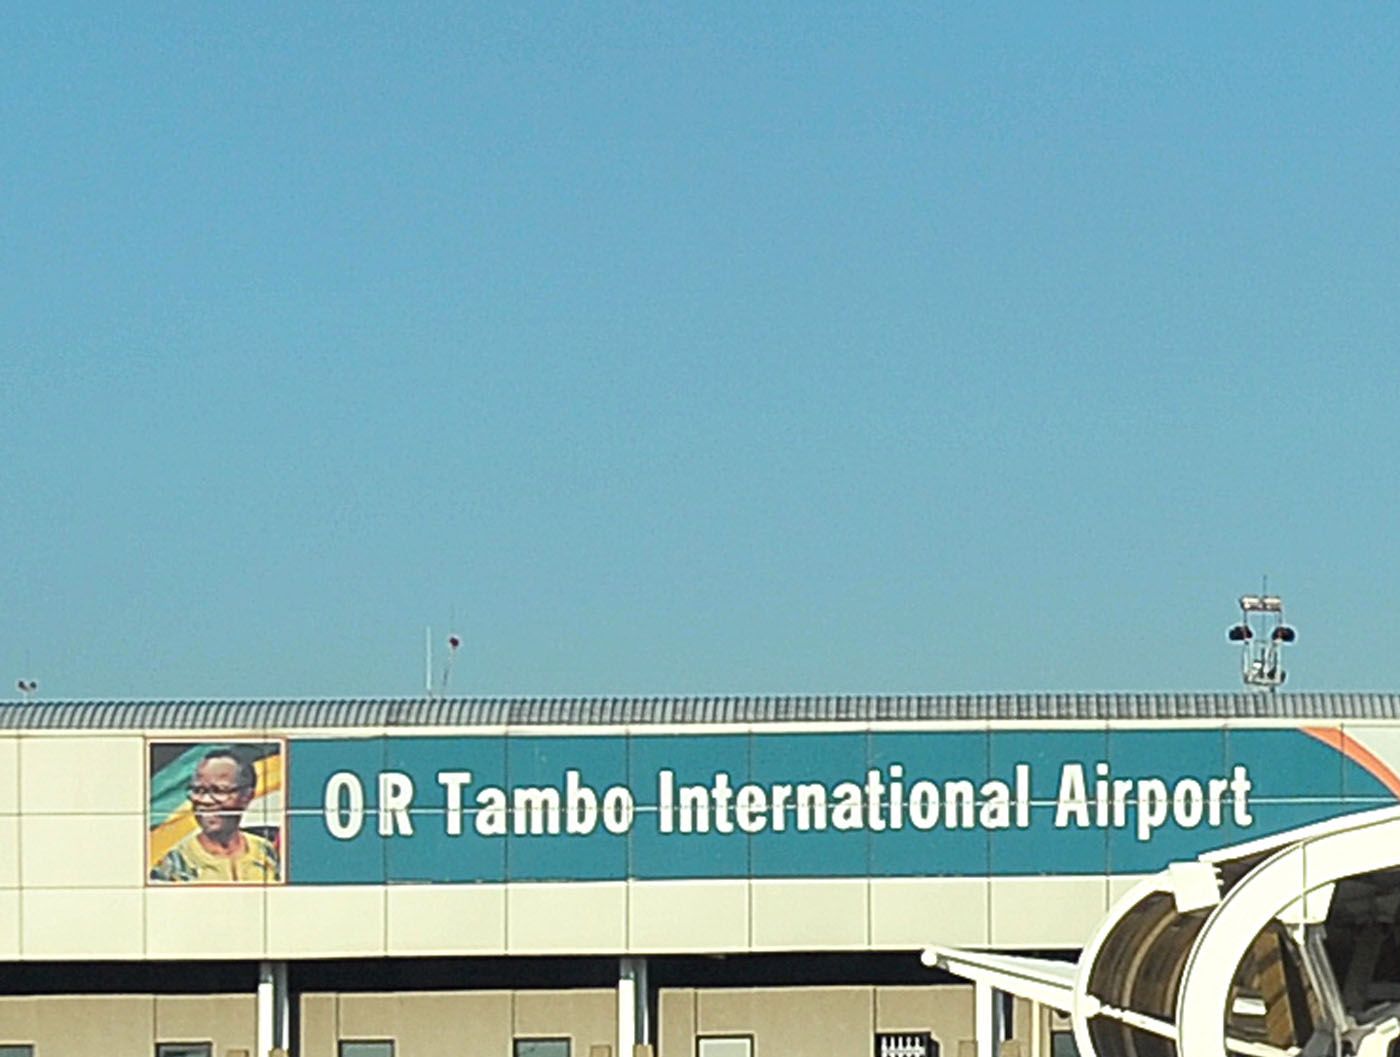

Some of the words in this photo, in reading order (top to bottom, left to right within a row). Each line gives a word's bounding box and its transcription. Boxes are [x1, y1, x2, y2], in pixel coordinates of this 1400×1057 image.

[437, 769, 634, 836] Tambo
[658, 763, 1030, 834] International
[1055, 762, 1253, 841] Airport
